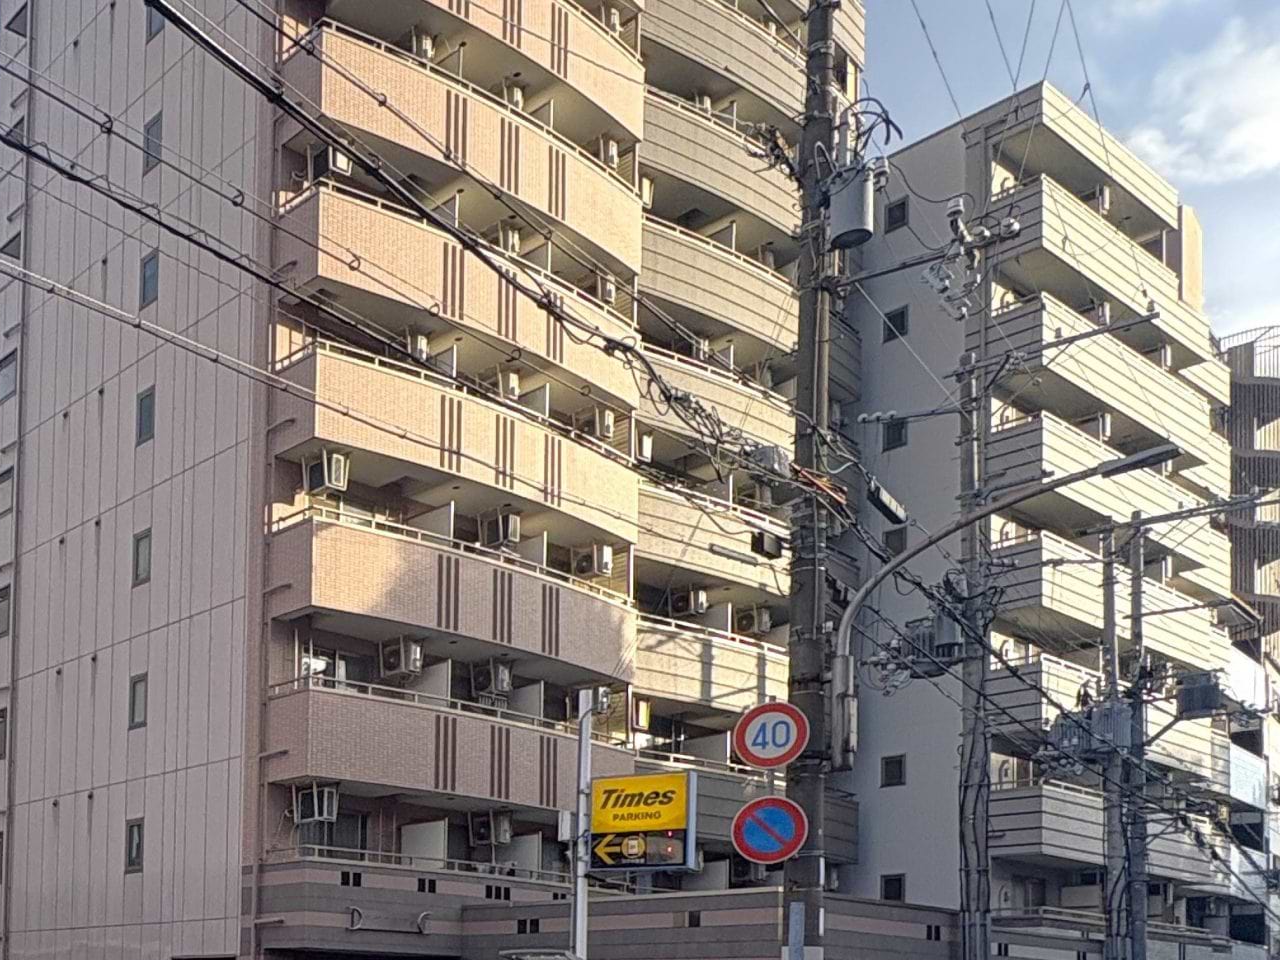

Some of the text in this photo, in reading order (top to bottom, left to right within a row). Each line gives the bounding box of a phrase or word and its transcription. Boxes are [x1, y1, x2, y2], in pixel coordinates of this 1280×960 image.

[751, 720, 791, 750] 40
[600, 788, 676, 810] Times
[612, 810, 662, 822] PARKING
